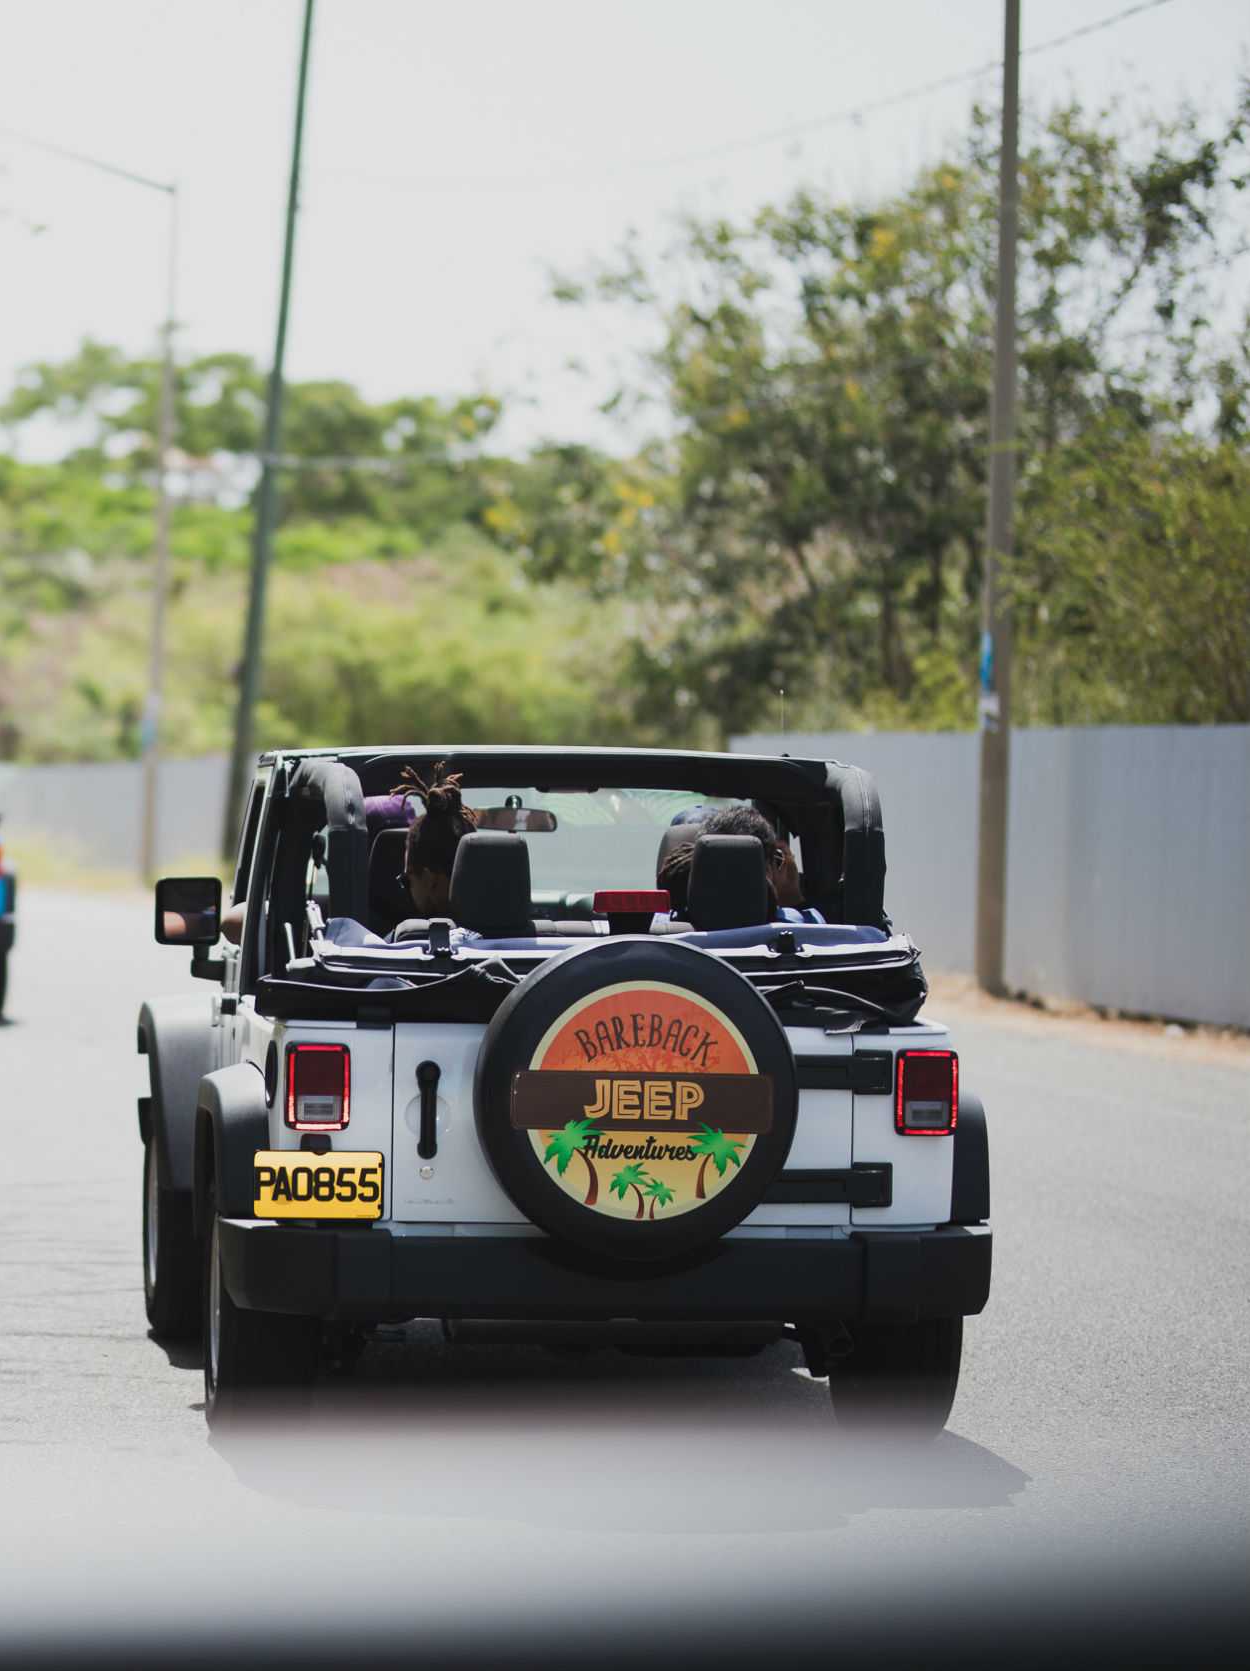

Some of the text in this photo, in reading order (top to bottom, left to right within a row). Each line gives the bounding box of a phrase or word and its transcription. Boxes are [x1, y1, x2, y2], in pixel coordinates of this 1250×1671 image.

[574, 1013, 718, 1067] BAREBACK
[583, 1079, 704, 1121] JEEP
[581, 1135, 698, 1161] Adventures
[254, 1166, 380, 1203] PA0855
